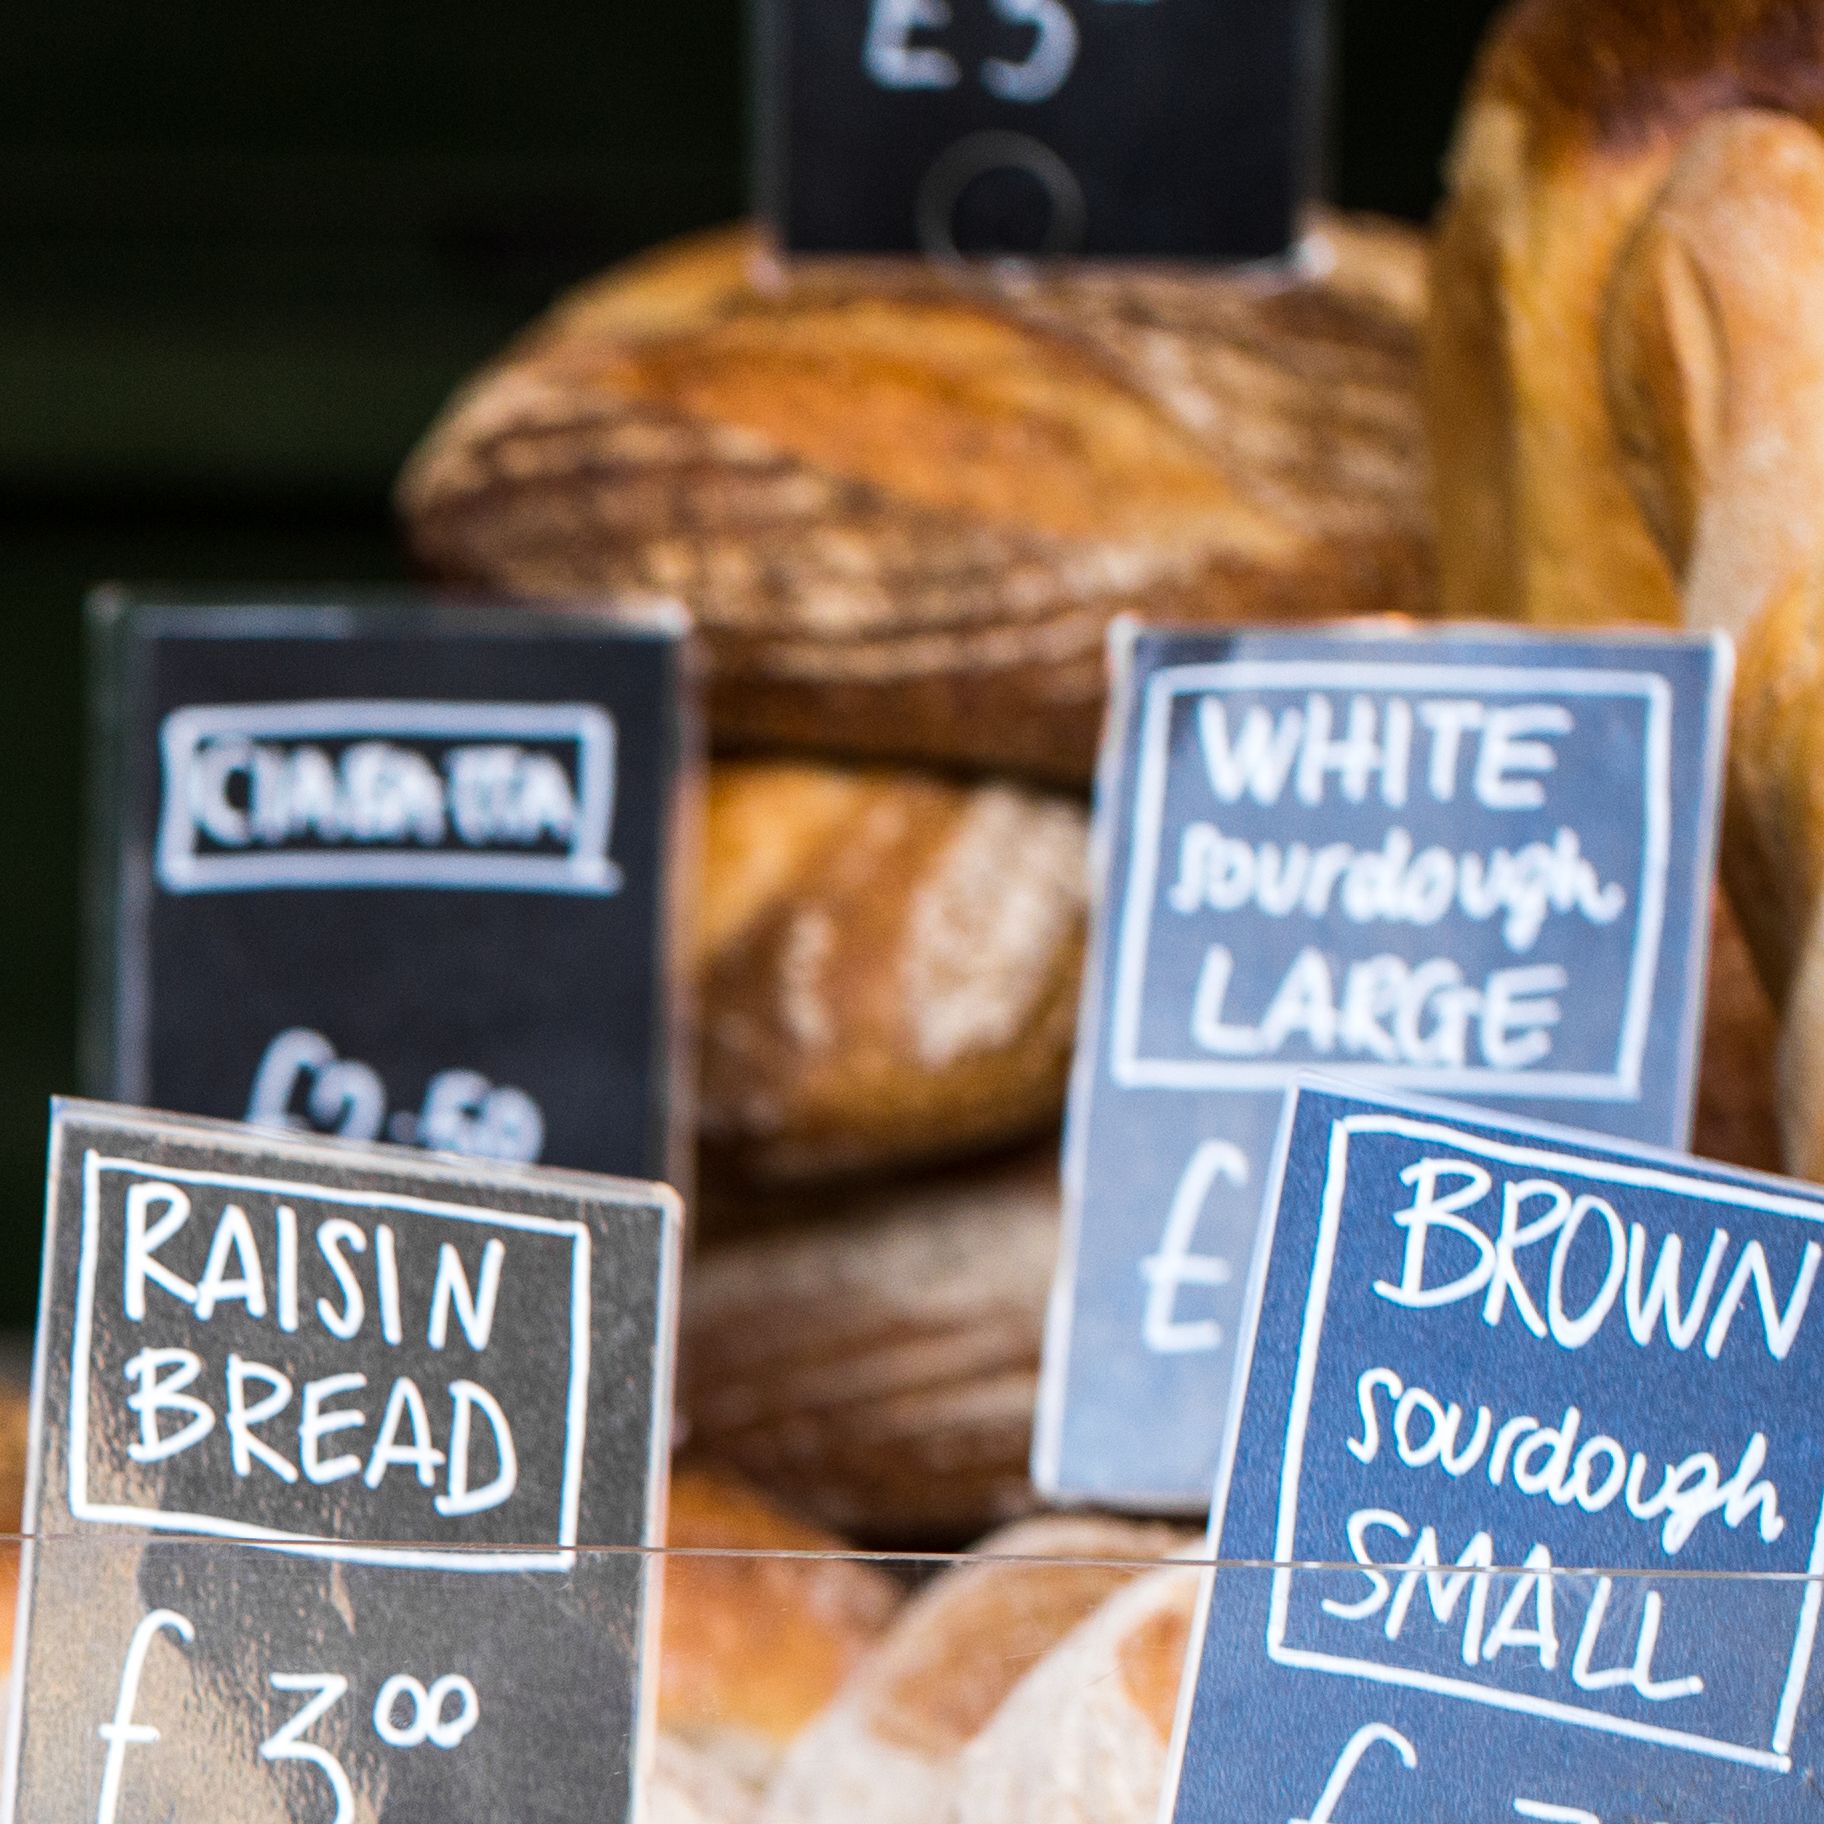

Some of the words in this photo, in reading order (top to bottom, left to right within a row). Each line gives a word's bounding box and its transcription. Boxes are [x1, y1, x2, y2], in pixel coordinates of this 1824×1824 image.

[1197, 694, 1573, 810] WHITE
[1190, 944, 1567, 1068] LARGE
[124, 1181, 505, 1352] RAISIN
[1140, 1138, 1248, 1353] £
[1373, 1157, 1822, 1360] BROWN
[124, 1346, 518, 1517] BREAD
[1322, 1508, 1703, 1699] SMALL
